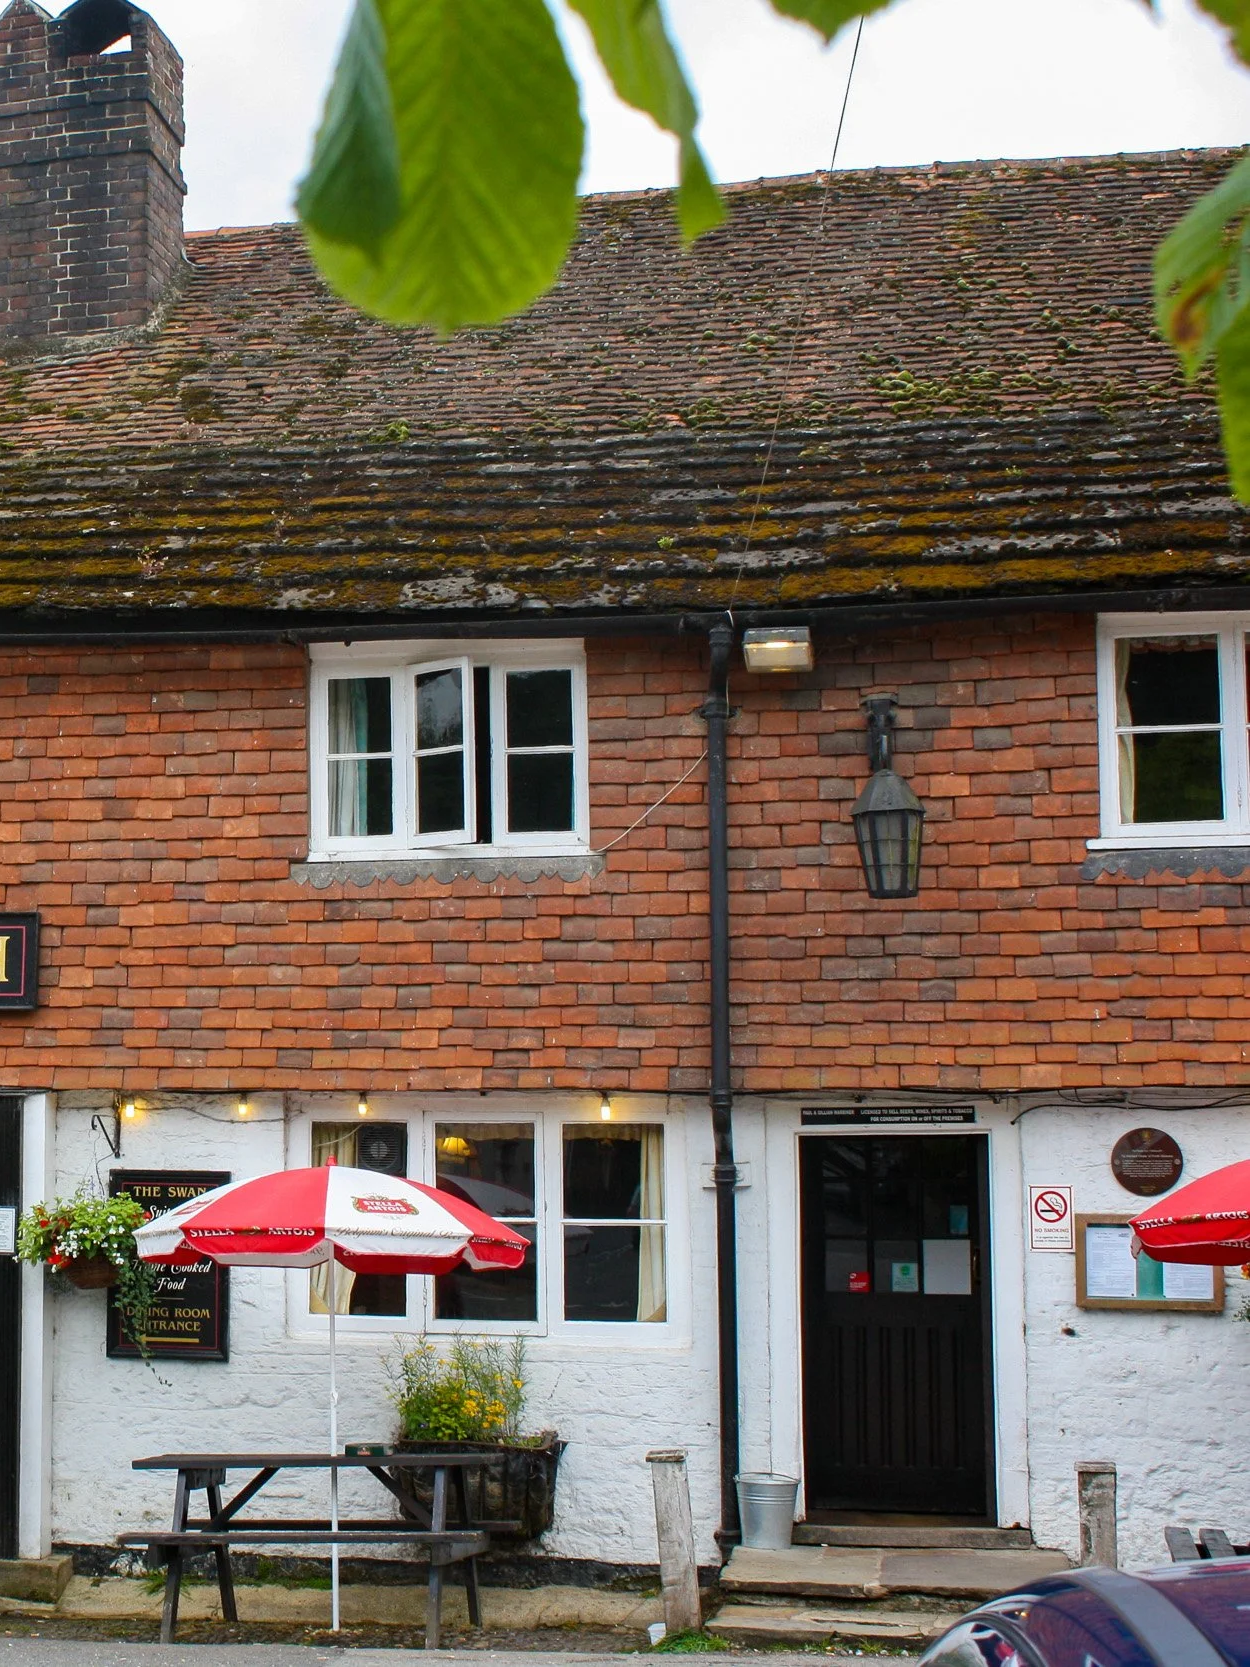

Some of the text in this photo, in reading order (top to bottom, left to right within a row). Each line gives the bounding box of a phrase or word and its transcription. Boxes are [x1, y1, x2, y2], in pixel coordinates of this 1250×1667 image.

[133, 1186, 207, 1198] THE SWAN
[1136, 1217, 1176, 1230] STELLA
[189, 1228, 234, 1238] STELLA
[268, 1228, 315, 1236] ARTOIS
[153, 1278, 187, 1293] Food
[175, 1308, 210, 1319] ROOM
